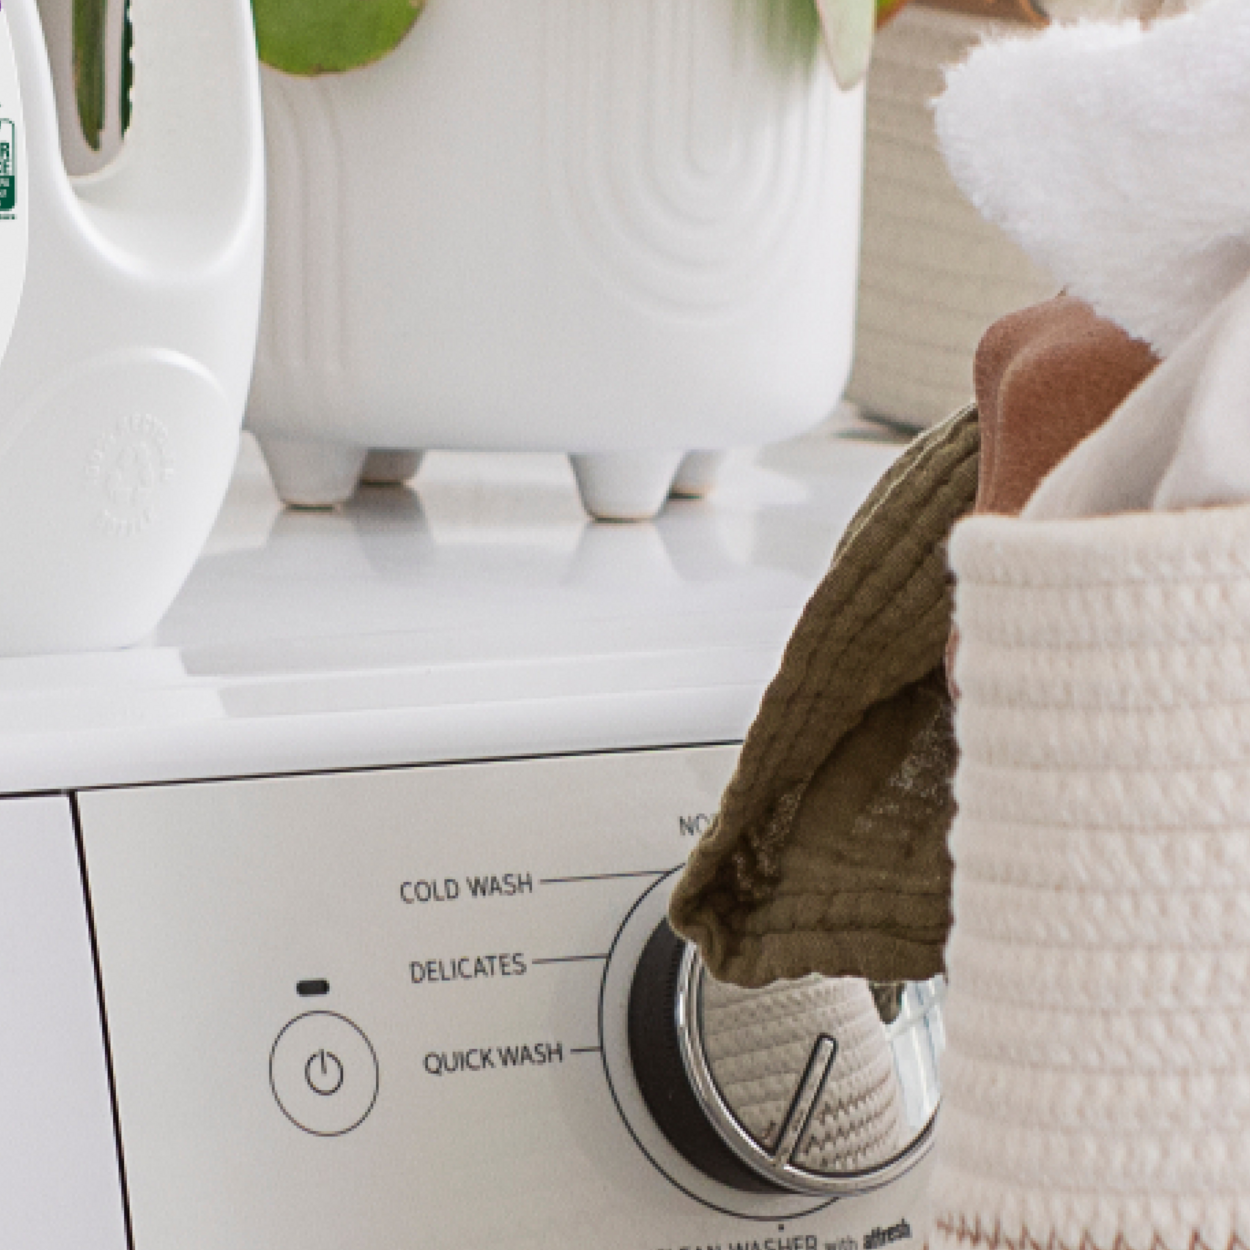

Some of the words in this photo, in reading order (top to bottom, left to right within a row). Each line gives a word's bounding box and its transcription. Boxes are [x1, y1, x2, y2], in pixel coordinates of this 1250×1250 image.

[400, 878, 459, 903] COLD
[466, 871, 532, 898] WASH
[409, 952, 527, 984] DELICATES
[423, 1048, 496, 1076] QUICK
[497, 1041, 563, 1068] WASH
[863, 1216, 912, 1249] affresh
